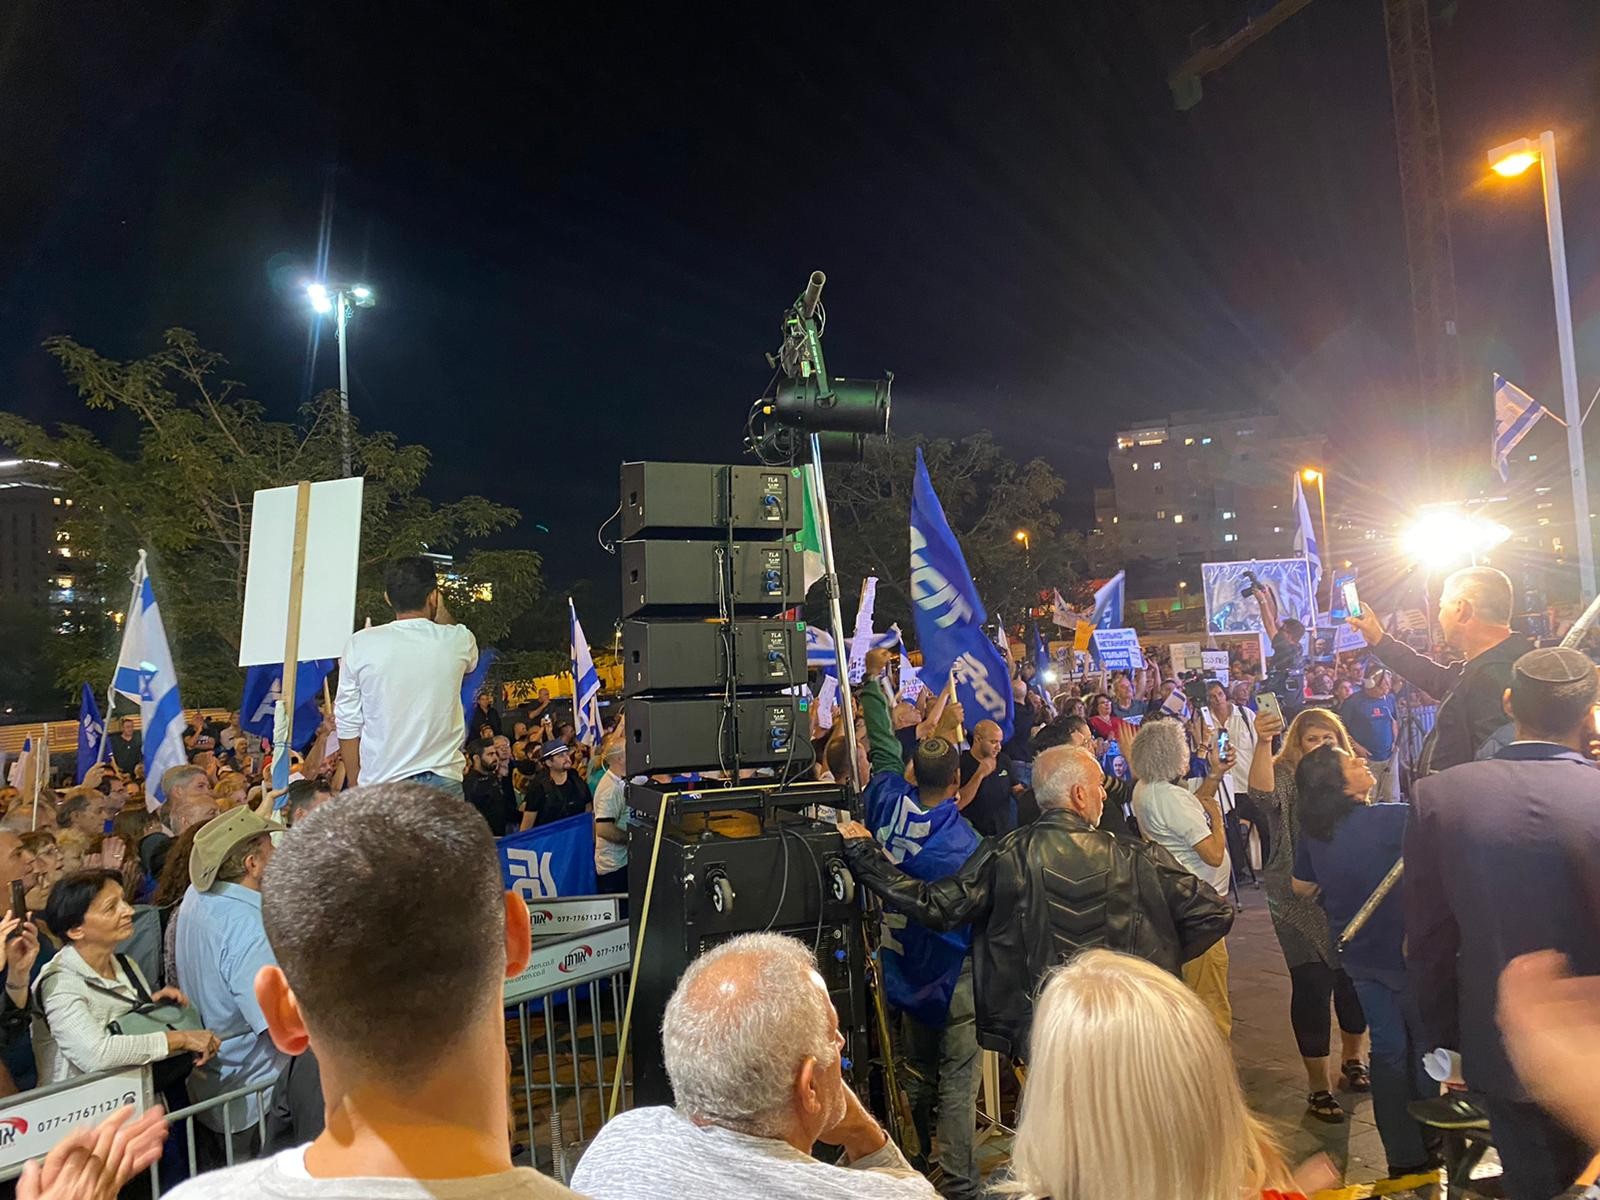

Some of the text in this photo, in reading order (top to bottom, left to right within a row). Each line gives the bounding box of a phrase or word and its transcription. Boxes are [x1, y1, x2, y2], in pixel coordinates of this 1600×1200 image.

[1101, 651, 1129, 659] ТОЛЬКО
[557, 914, 602, 923] 077-7767127
[564, 950, 588, 970] אורתן
[38, 1098, 119, 1133] 077-7767127
